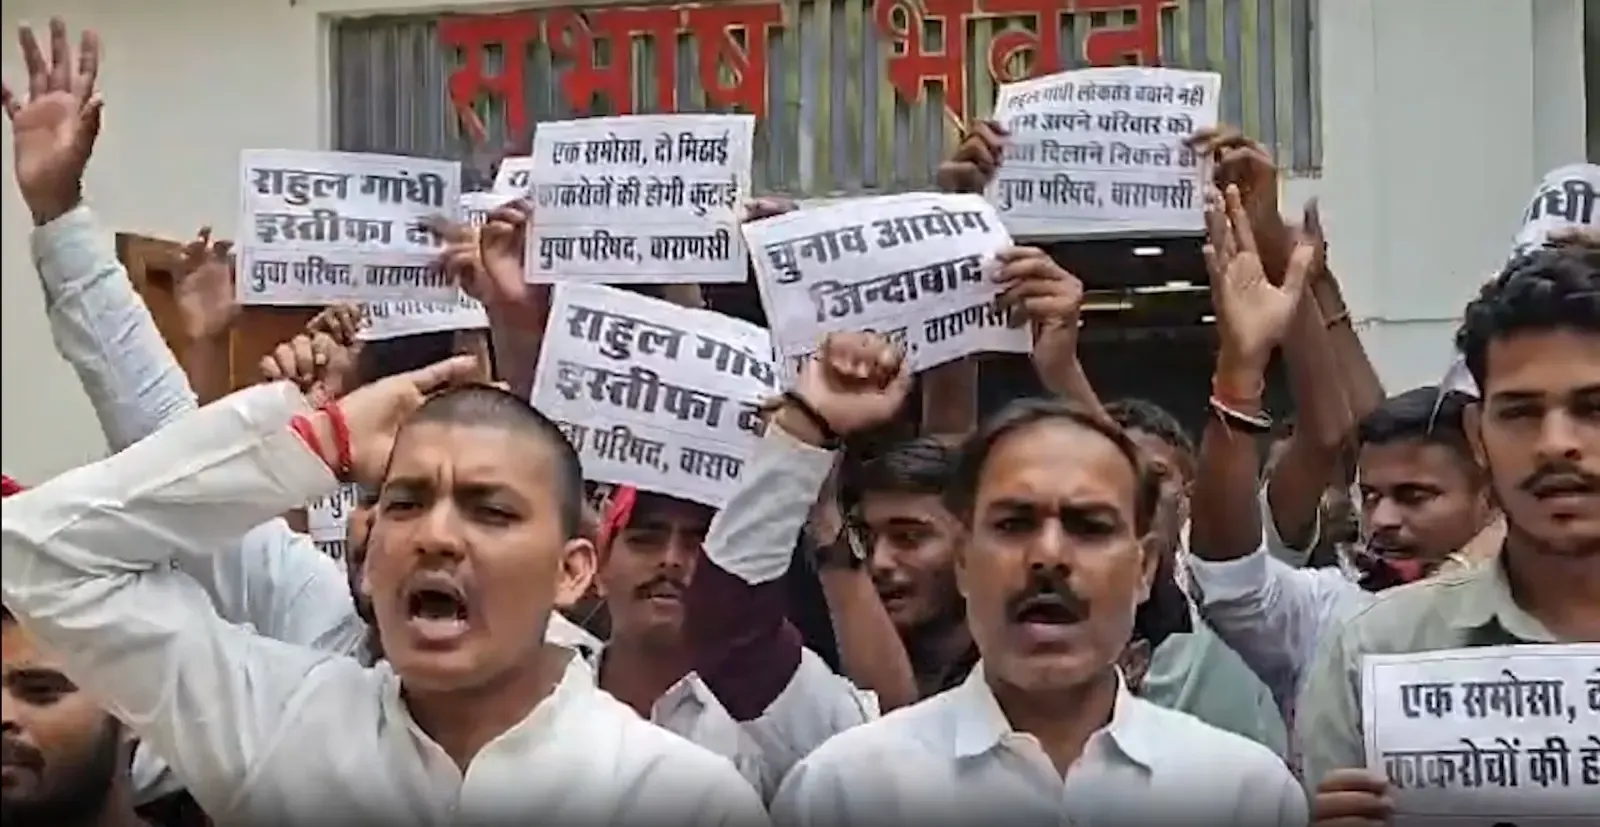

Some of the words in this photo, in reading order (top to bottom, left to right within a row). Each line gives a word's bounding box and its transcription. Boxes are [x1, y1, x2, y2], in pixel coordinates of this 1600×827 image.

[1041, 109, 1093, 132] अपने
[1097, 110, 1162, 134] परिवार
[1167, 112, 1193, 134] को
[552, 141, 583, 165] एक
[585, 132, 648, 167] समोसा,
[654, 133, 674, 164] दो
[678, 130, 731, 166] मिठाई
[1040, 138, 1104, 165] दिलाने
[1109, 141, 1170, 166] निकले
[251, 168, 353, 205] राहुल
[360, 171, 448, 207] गांधी
[616, 176, 642, 208] की
[645, 175, 685, 208] होगी
[687, 174, 739, 216] कुटाई
[1111, 178, 1194, 209] वाराणसी
[253, 209, 394, 244] इस्तीफा
[765, 224, 868, 285] चुनाव
[872, 206, 990, 247] आयोग
[540, 236, 576, 269] युवा
[579, 229, 643, 265] परिषद,
[650, 228, 732, 262] वाराणसी
[252, 260, 287, 291] युवा
[809, 253, 985, 323] जिन्दाबाद
[568, 304, 688, 360] राहुल
[696, 334, 775, 388] गांध
[555, 360, 728, 427] इस्तीफा
[592, 425, 669, 473] परिषद,
[680, 446, 745, 482] वाराण
[1400, 682, 1454, 719] एक
[1461, 668, 1577, 724] समोसा,
[1382, 737, 1521, 789] काकरोचों
[1526, 736, 1572, 788] की
